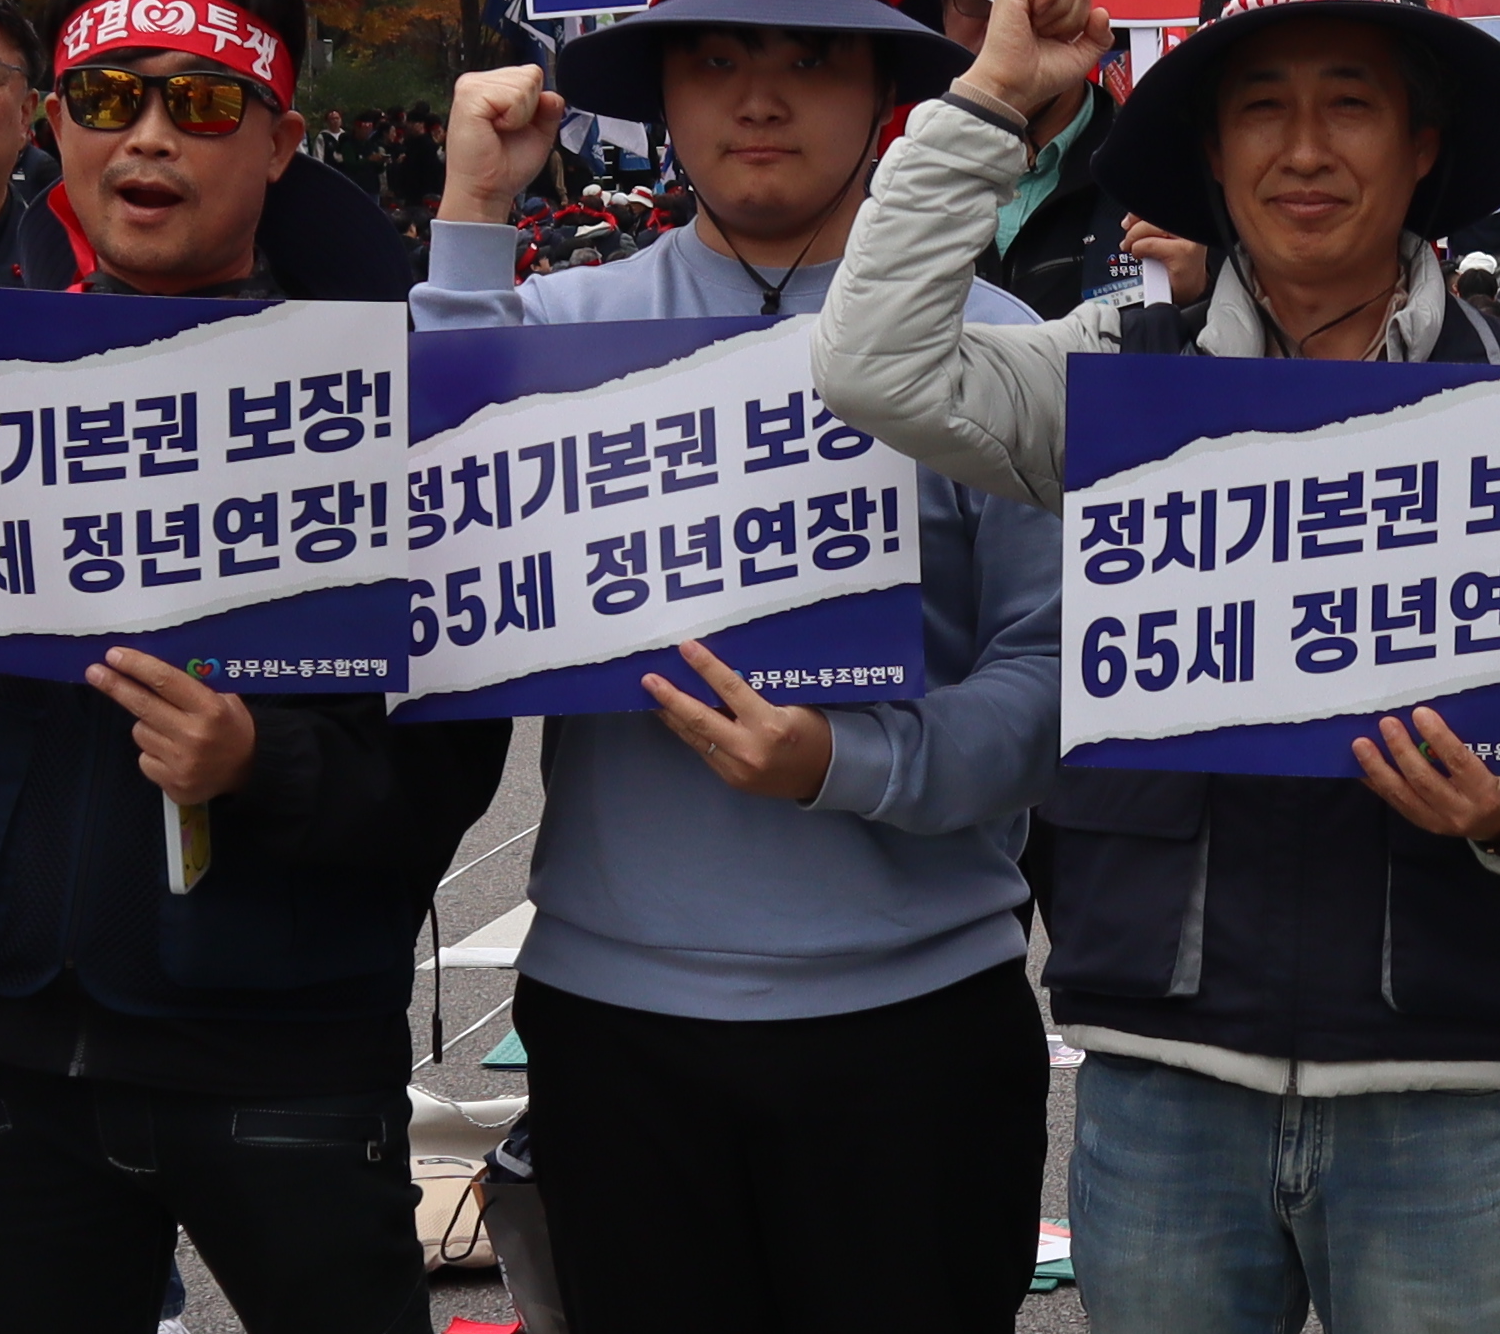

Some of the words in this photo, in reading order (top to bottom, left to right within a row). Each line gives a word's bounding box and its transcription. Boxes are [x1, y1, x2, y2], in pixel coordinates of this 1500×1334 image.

[199, 1, 279, 82] 투쟁
[226, 369, 391, 463] 보장!
[408, 407, 718, 551] 정치기본권
[744, 387, 875, 474] 보장
[63, 480, 387, 593] 정년연장!
[408, 551, 556, 657] 65세
[586, 486, 899, 615] 정년연장!
[1081, 461, 1438, 585] 정치기본권
[225, 658, 388, 678] 공무원노동조합연맹
[748, 665, 905, 690] 공무원노동조합연맹
[1082, 600, 1255, 698] 65세
